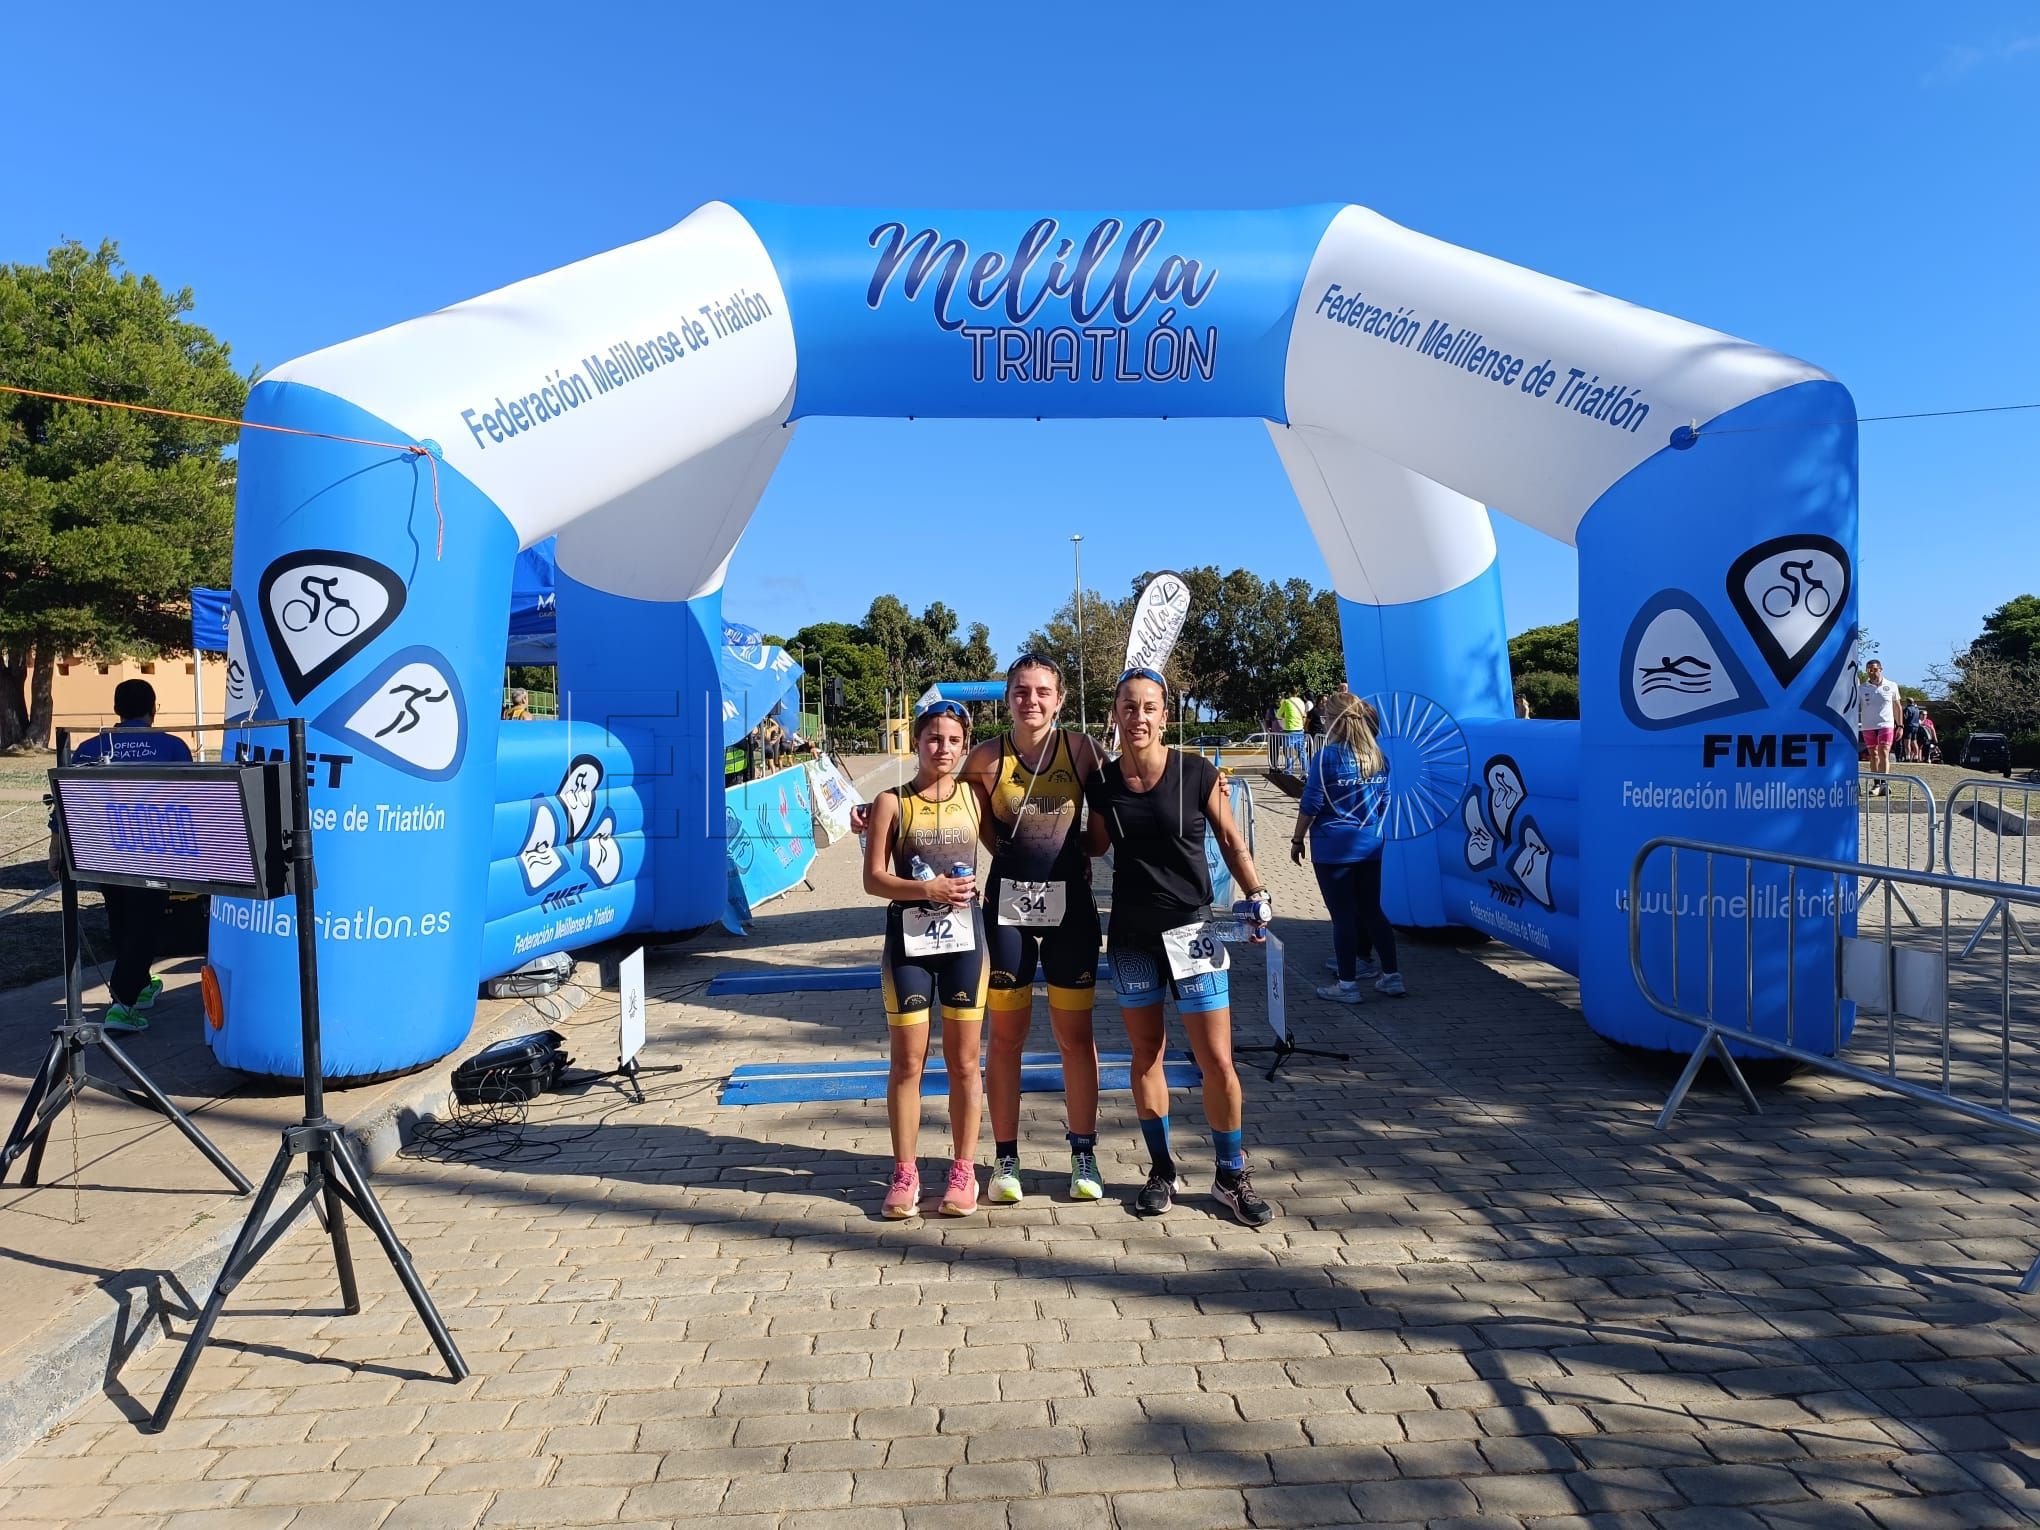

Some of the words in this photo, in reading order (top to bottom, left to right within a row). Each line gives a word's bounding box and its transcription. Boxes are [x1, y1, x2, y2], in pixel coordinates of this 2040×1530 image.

[866, 217, 1219, 331] Melilla
[961, 307, 1219, 383] TRIATLÓN
[1315, 283, 1420, 348] Federación
[1416, 319, 1524, 386] Melillense
[1521, 359, 1556, 398] de
[1555, 368, 1650, 433] Triatlón
[460, 369, 593, 449] Federación
[581, 340, 685, 395] Melillense
[681, 315, 710, 352] de
[698, 288, 773, 339] Triatlón
[114, 741, 152, 749] OFICIAL
[1703, 734, 1834, 769] FMET
[1011, 796, 1070, 816] CASTILLO
[1622, 780, 1728, 810] Federación
[1735, 781, 1826, 810] Melillense
[1829, 780, 1844, 809] de
[343, 804, 369, 832] de
[375, 802, 446, 832] Triatlón
[915, 826, 971, 846] ROMERO
[540, 882, 589, 914] FMET
[1020, 896, 1047, 914] 34
[512, 923, 554, 956] Federación
[553, 915, 586, 941] Melillense
[584, 911, 594, 931] de
[593, 904, 615, 928] Triatlón
[925, 919, 954, 941] 42
[1188, 937, 1215, 960] 39
